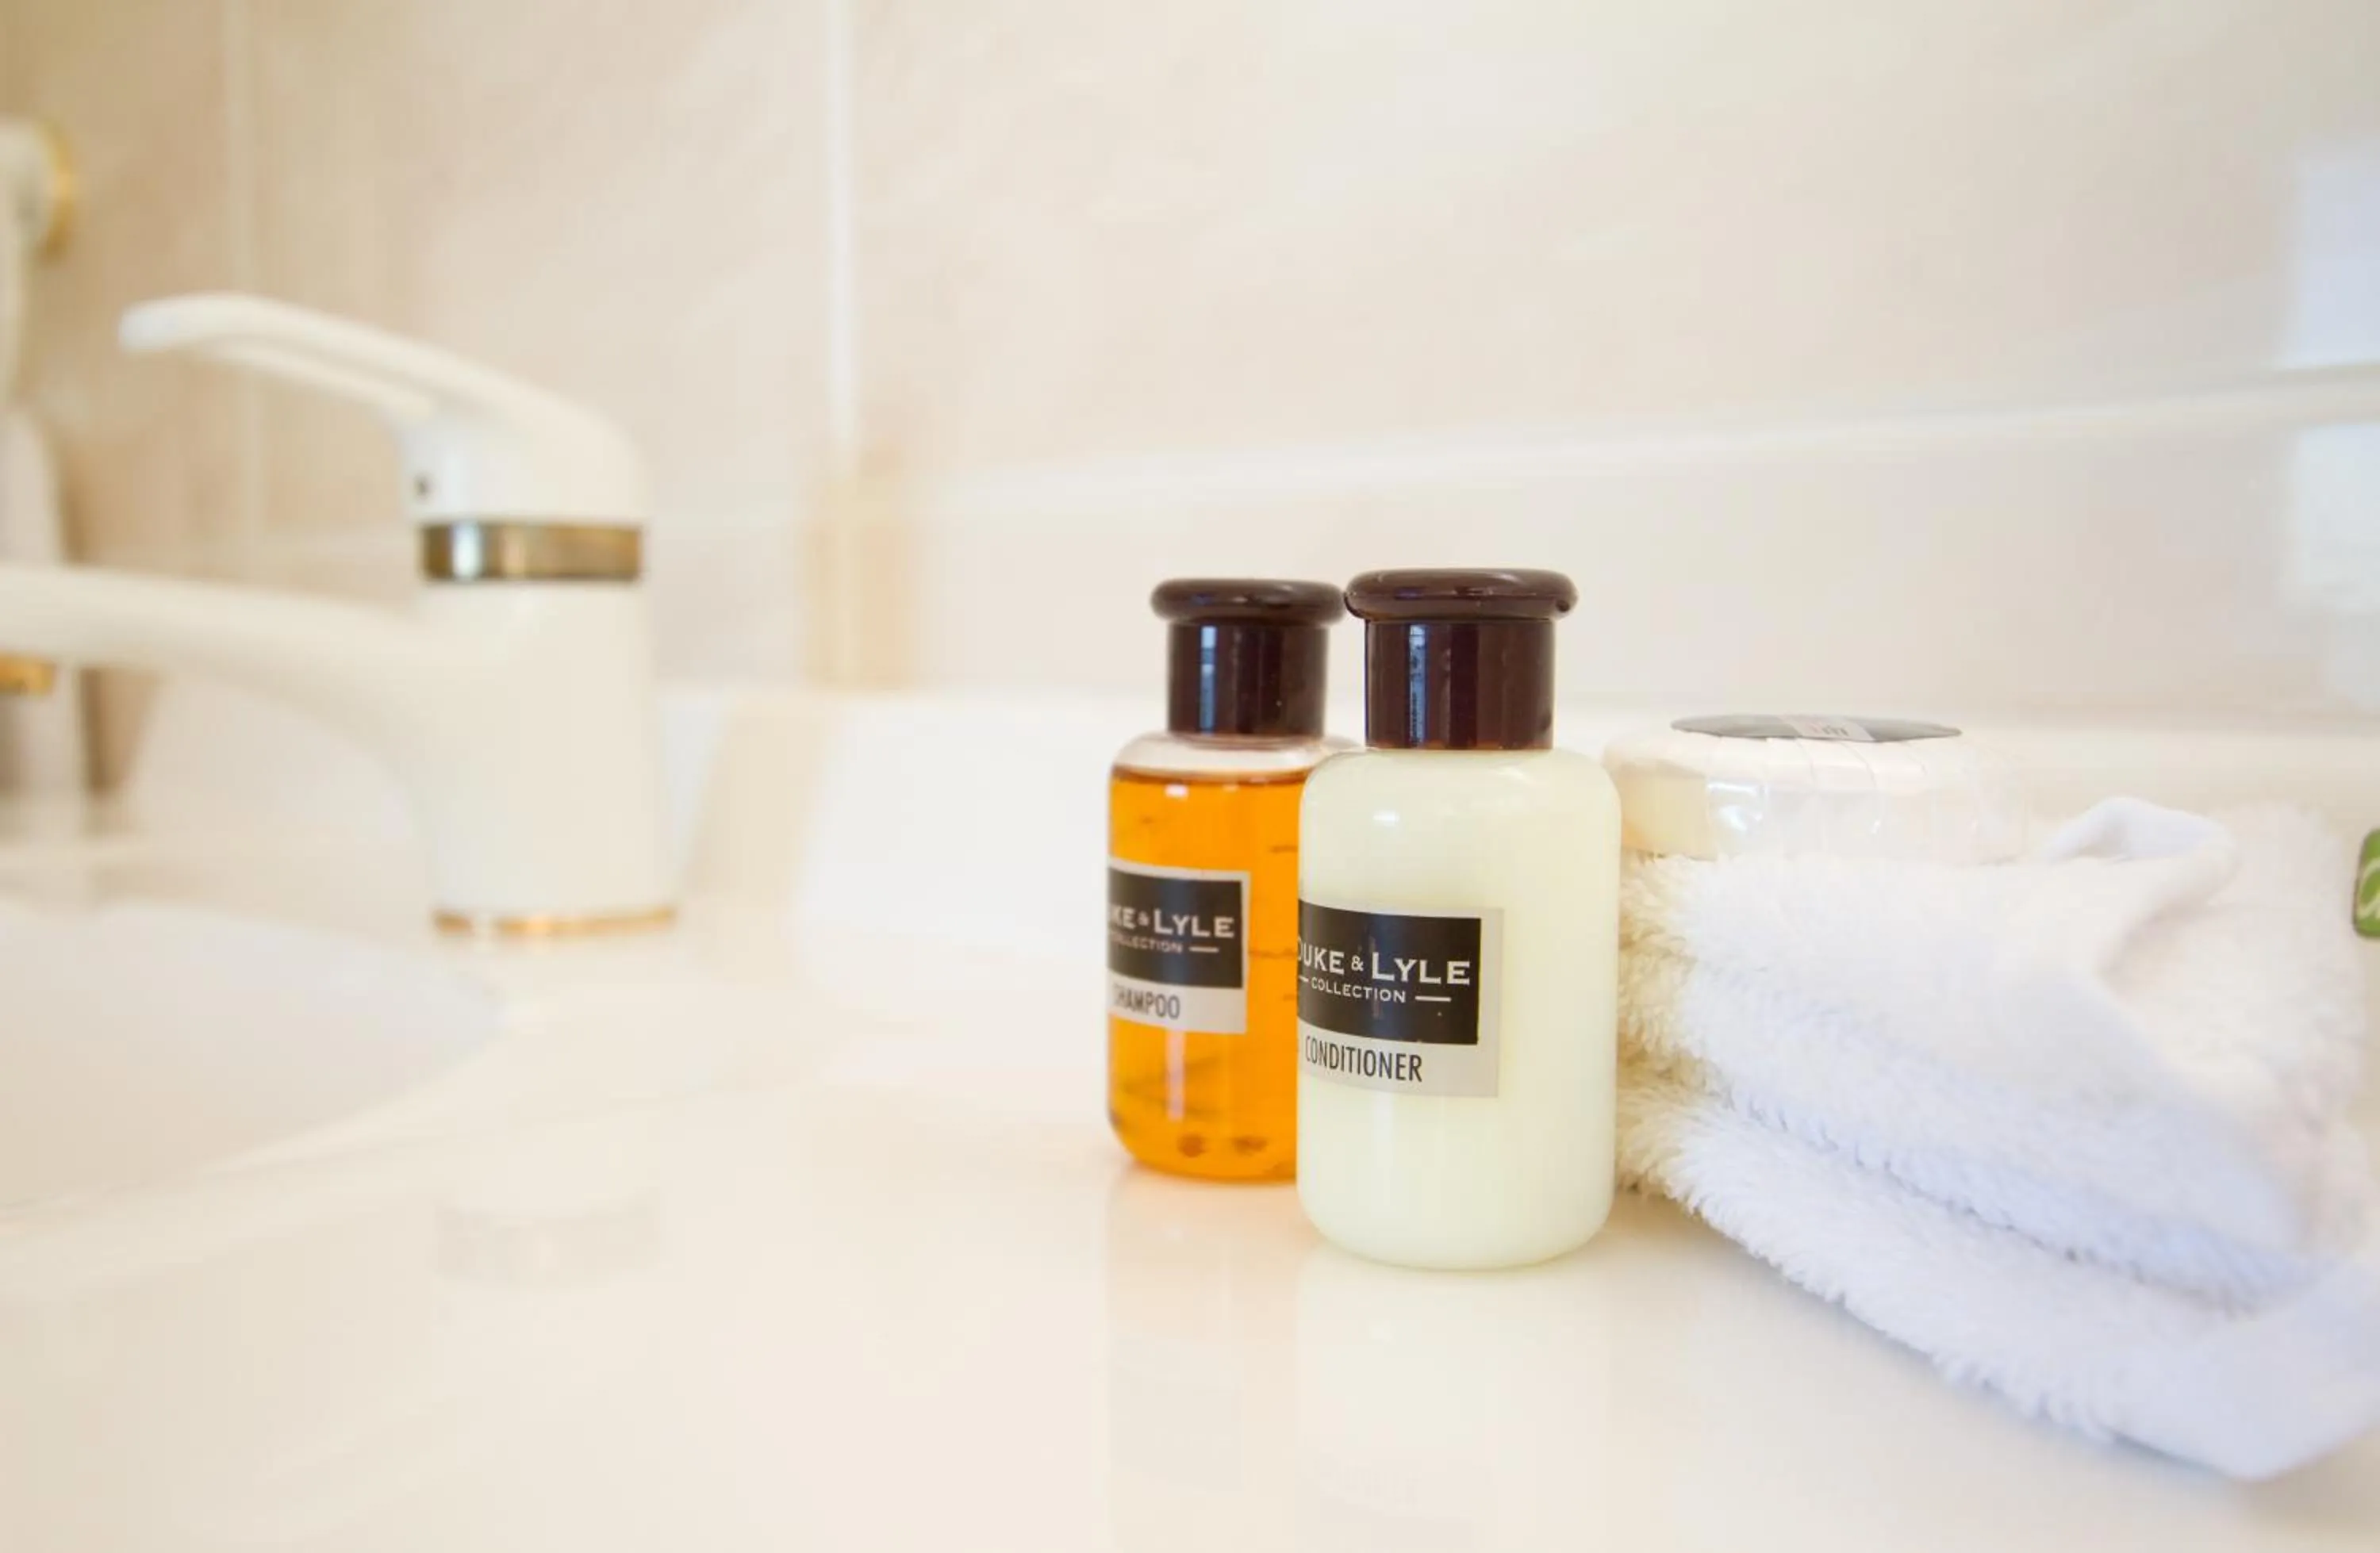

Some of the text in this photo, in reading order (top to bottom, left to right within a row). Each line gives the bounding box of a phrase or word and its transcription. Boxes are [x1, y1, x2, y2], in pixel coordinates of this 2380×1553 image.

[1108, 903, 1234, 938] KE & LYLE
[1351, 954, 1364, 972] &
[1372, 951, 1470, 985] LYLE
[1311, 976, 1406, 1003] COLLECTION
[1305, 1035, 1422, 1082] CONDITIONER
